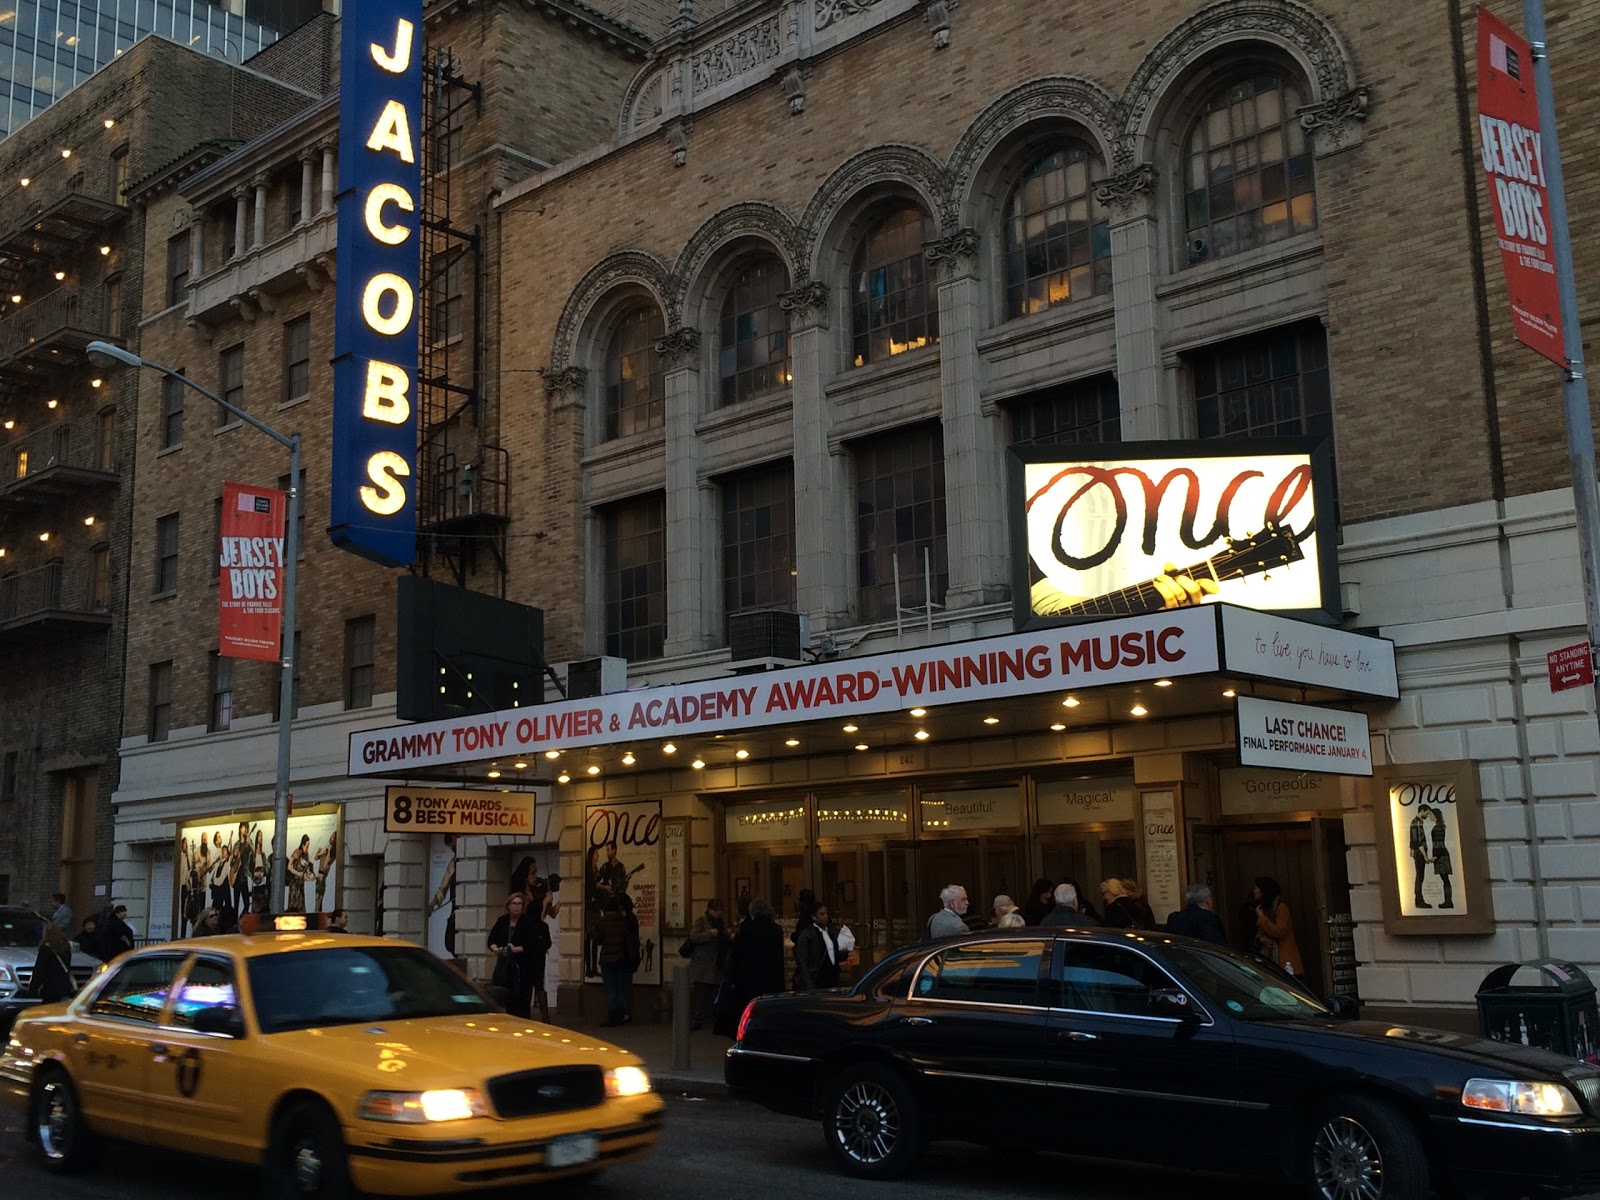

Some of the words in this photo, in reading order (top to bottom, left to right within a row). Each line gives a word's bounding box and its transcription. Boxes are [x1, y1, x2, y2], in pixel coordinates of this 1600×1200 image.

[1479, 114, 1546, 188] JERSEY
[1495, 177, 1547, 246] BOYS
[360, 18, 414, 515] JACOBS
[220, 537, 284, 568] JERSEY
[230, 569, 277, 599] BOYS
[1549, 654, 1558, 664] NO
[1559, 646, 1588, 662] STANDING
[1555, 659, 1585, 674] ANYTIME
[363, 731, 445, 765] GRAMMY
[452, 722, 509, 752] TONY
[516, 708, 602, 744] OLIVIER
[609, 715, 621, 732] &
[628, 687, 758, 730] ACADEMY
[765, 645, 1052, 714] AWARD-WINNING
[1060, 626, 1186, 676] MUSIC
[1265, 716, 1294, 737] LAST
[1297, 720, 1346, 742] CHANCE!
[1243, 736, 1267, 751] FINAL
[1269, 739, 1326, 757] PERFORMANCE
[1327, 745, 1360, 760] JANUARY
[1361, 749, 1367, 760] 4
[393, 796, 412, 824] 8
[416, 797, 449, 809] TONY
[452, 799, 501, 811] AWARDS
[416, 810, 456, 825] BEST
[460, 811, 528, 827] MUSICAL
